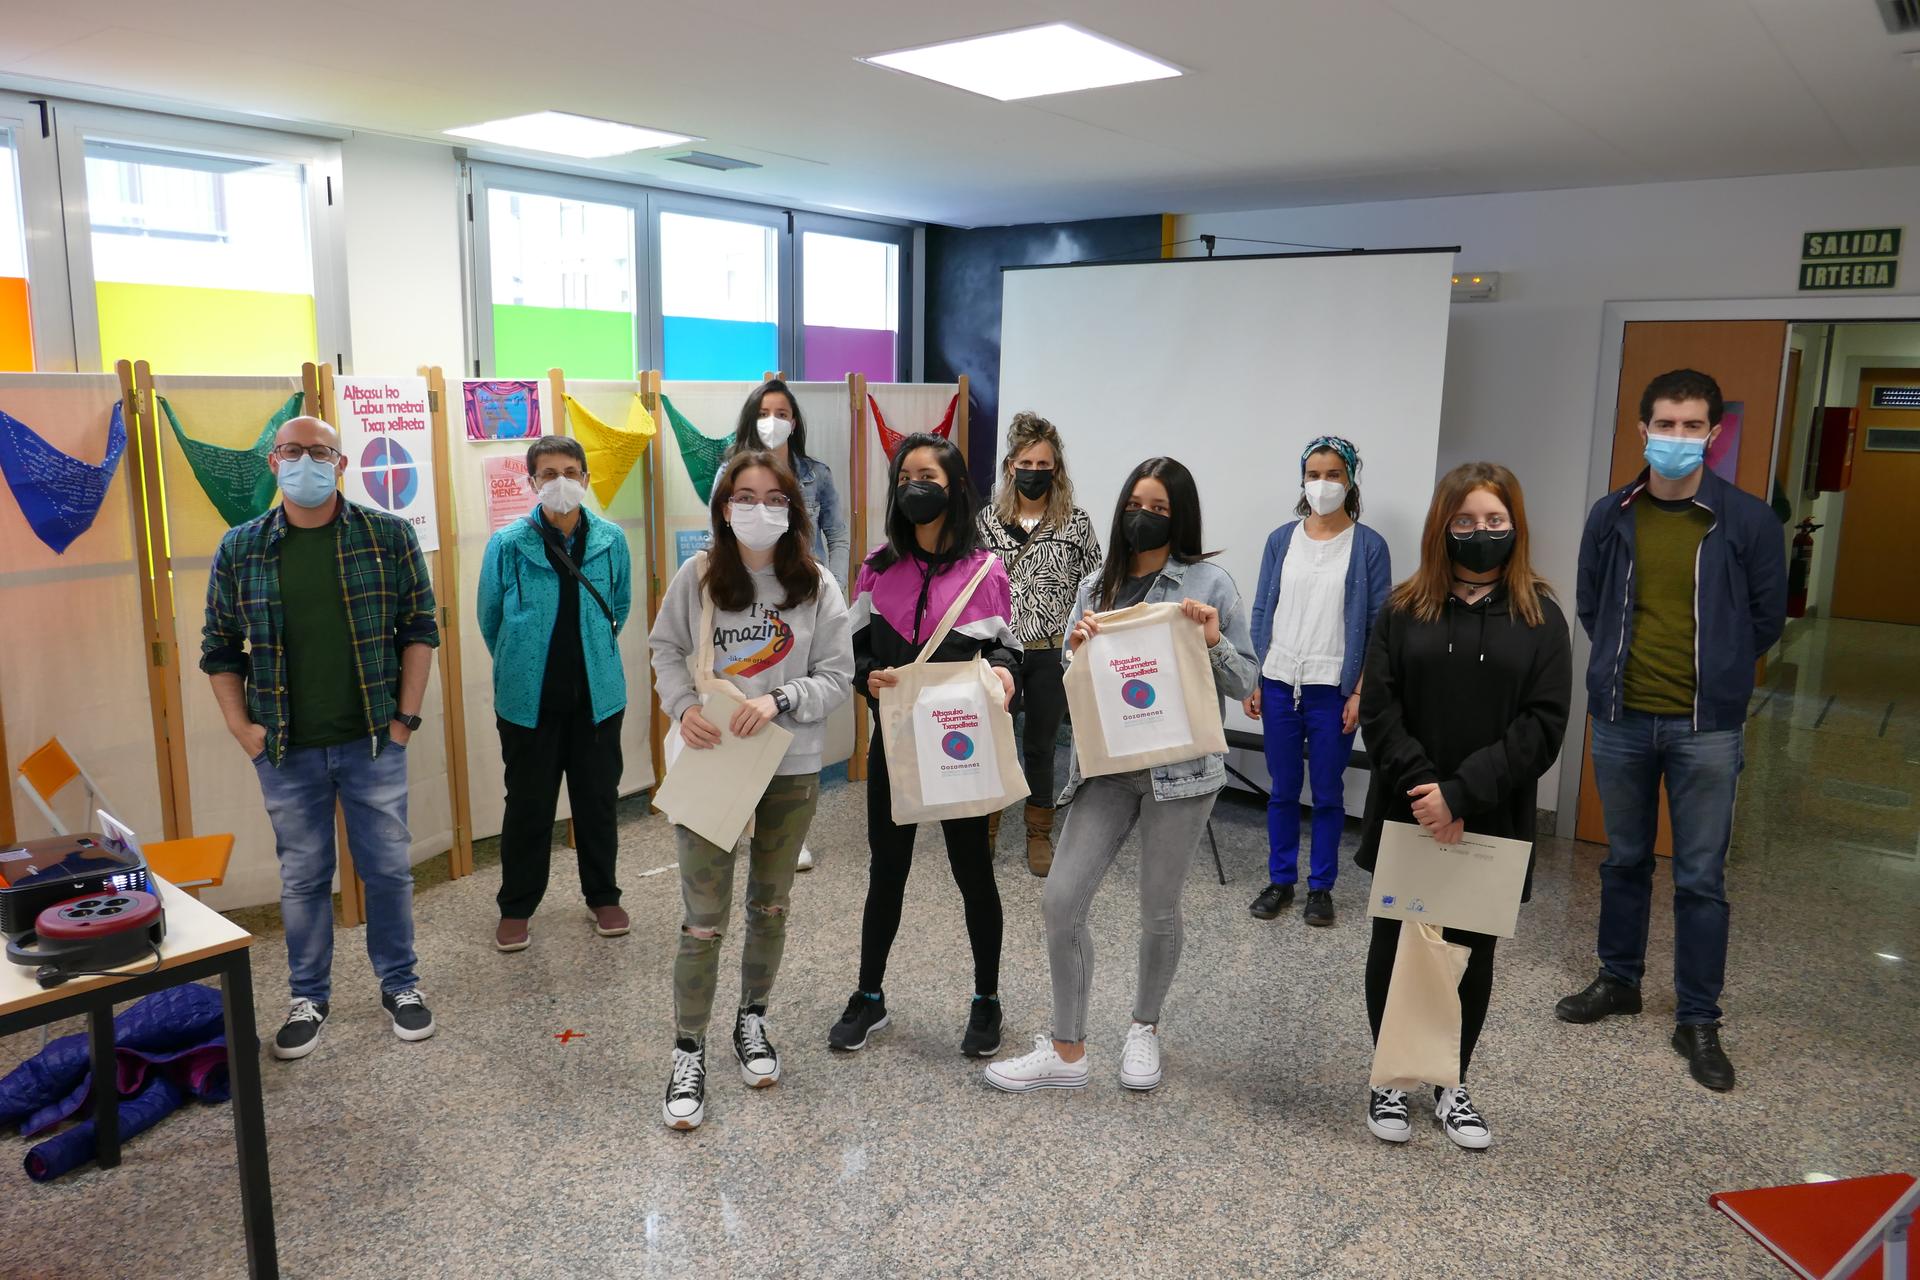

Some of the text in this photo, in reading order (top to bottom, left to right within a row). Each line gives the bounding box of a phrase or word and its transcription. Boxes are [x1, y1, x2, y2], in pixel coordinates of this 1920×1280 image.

[1809, 233, 1892, 255] SALIDA
[1806, 265, 1889, 286] IRTEERA
[490, 478, 517, 488] GOZA
[491, 487, 523, 498] MENEZ
[750, 603, 780, 620] I'm
[713, 620, 792, 653] Amazing
